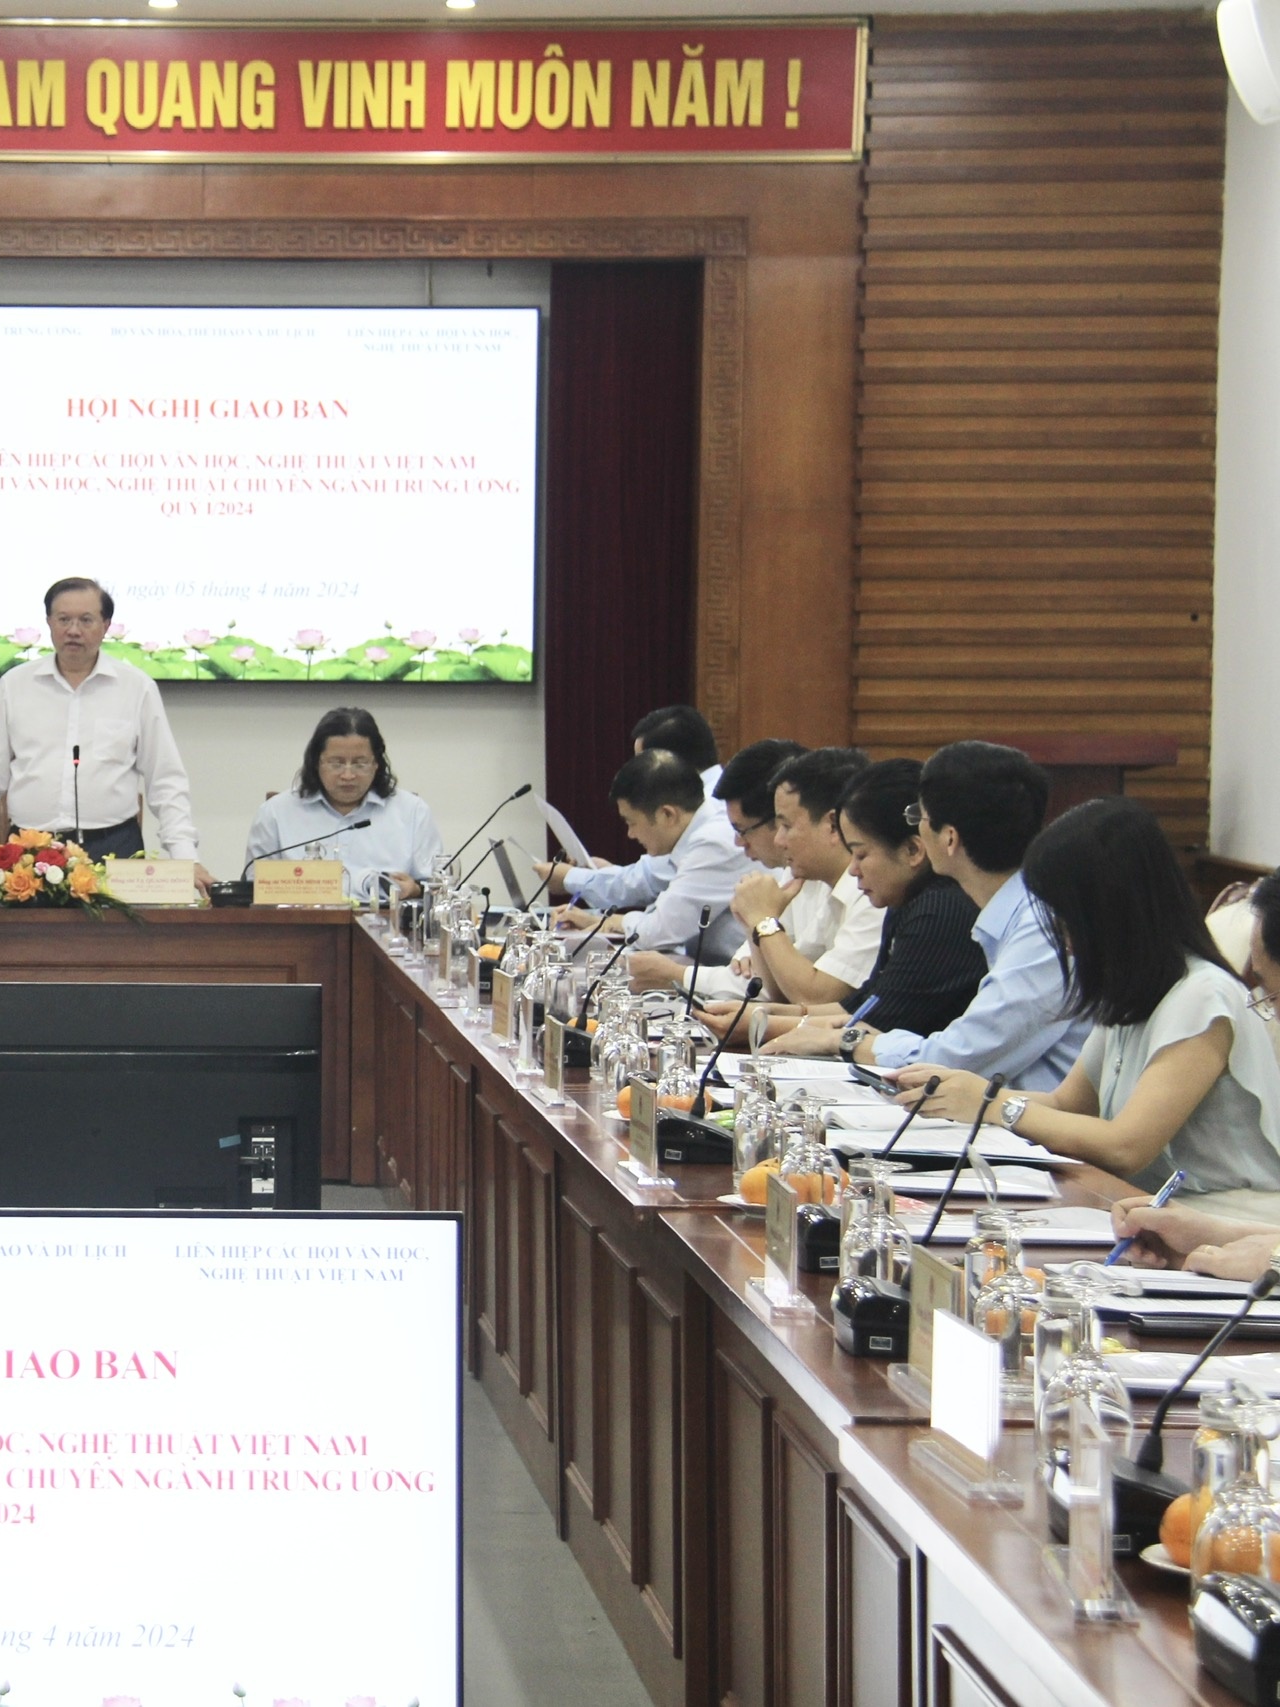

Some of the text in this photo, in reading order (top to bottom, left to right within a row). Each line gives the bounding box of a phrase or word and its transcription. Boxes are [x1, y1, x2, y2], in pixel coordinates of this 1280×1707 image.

[86, 58, 275, 136] QUANG
[298, 60, 426, 129] VINH
[445, 43, 611, 130] MUÔN
[630, 43, 765, 128] NĂM
[785, 59, 801, 129] !
[66, 395, 350, 424] HỘI NGHỊ GIAO BAN
[25, 1239, 51, 1257] VÀ
[55, 1244, 81, 1258] DU
[84, 1244, 128, 1262] LỊCH
[175, 1240, 430, 1263] LIÊN HIỆP CÁC HỘI VĂN HỌC,
[199, 1264, 404, 1285] NGHỆ THUẬT VIỆT NAM
[94, 1350, 178, 1380] BAN
[38, 1427, 118, 1462] NGHỆ
[125, 1428, 224, 1462] THUẬT
[227, 1428, 298, 1462] VIỆT
[302, 1434, 370, 1456] NAM
[5, 1460, 127, 1490] CHUYÊN
[134, 1462, 237, 1491] NGÀNH
[243, 1469, 343, 1492] TRUNG
[346, 1466, 436, 1493] ƯƠNG
[42, 1624, 58, 1649] 4
[66, 1624, 122, 1648] năm
[131, 1623, 198, 1649] 2024
